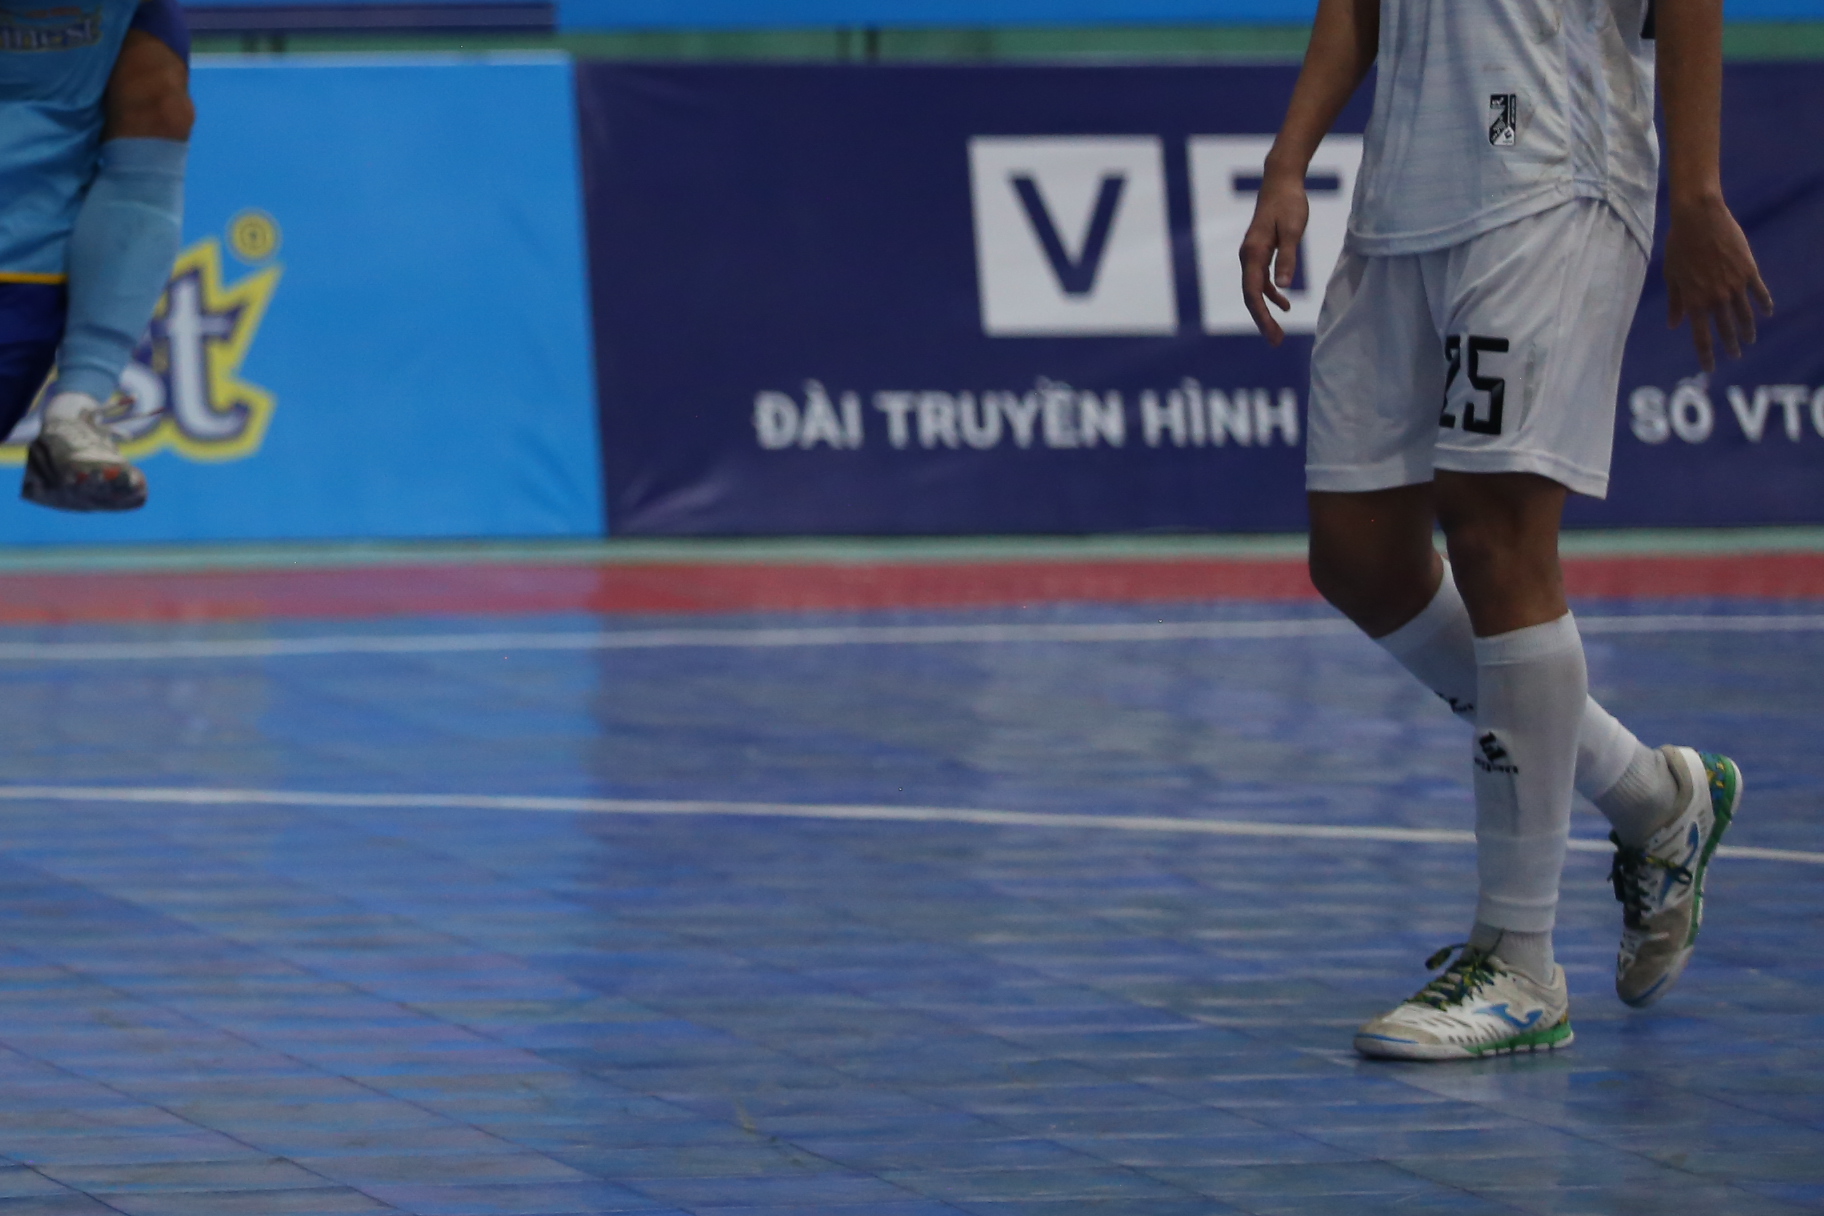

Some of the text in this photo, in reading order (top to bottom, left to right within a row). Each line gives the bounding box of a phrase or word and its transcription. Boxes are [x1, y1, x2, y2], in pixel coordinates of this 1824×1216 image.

[753, 372, 1824, 450] ĐÀI TRUYỀN HÌNH SỐ VT
[1438, 335, 1510, 436] 25
